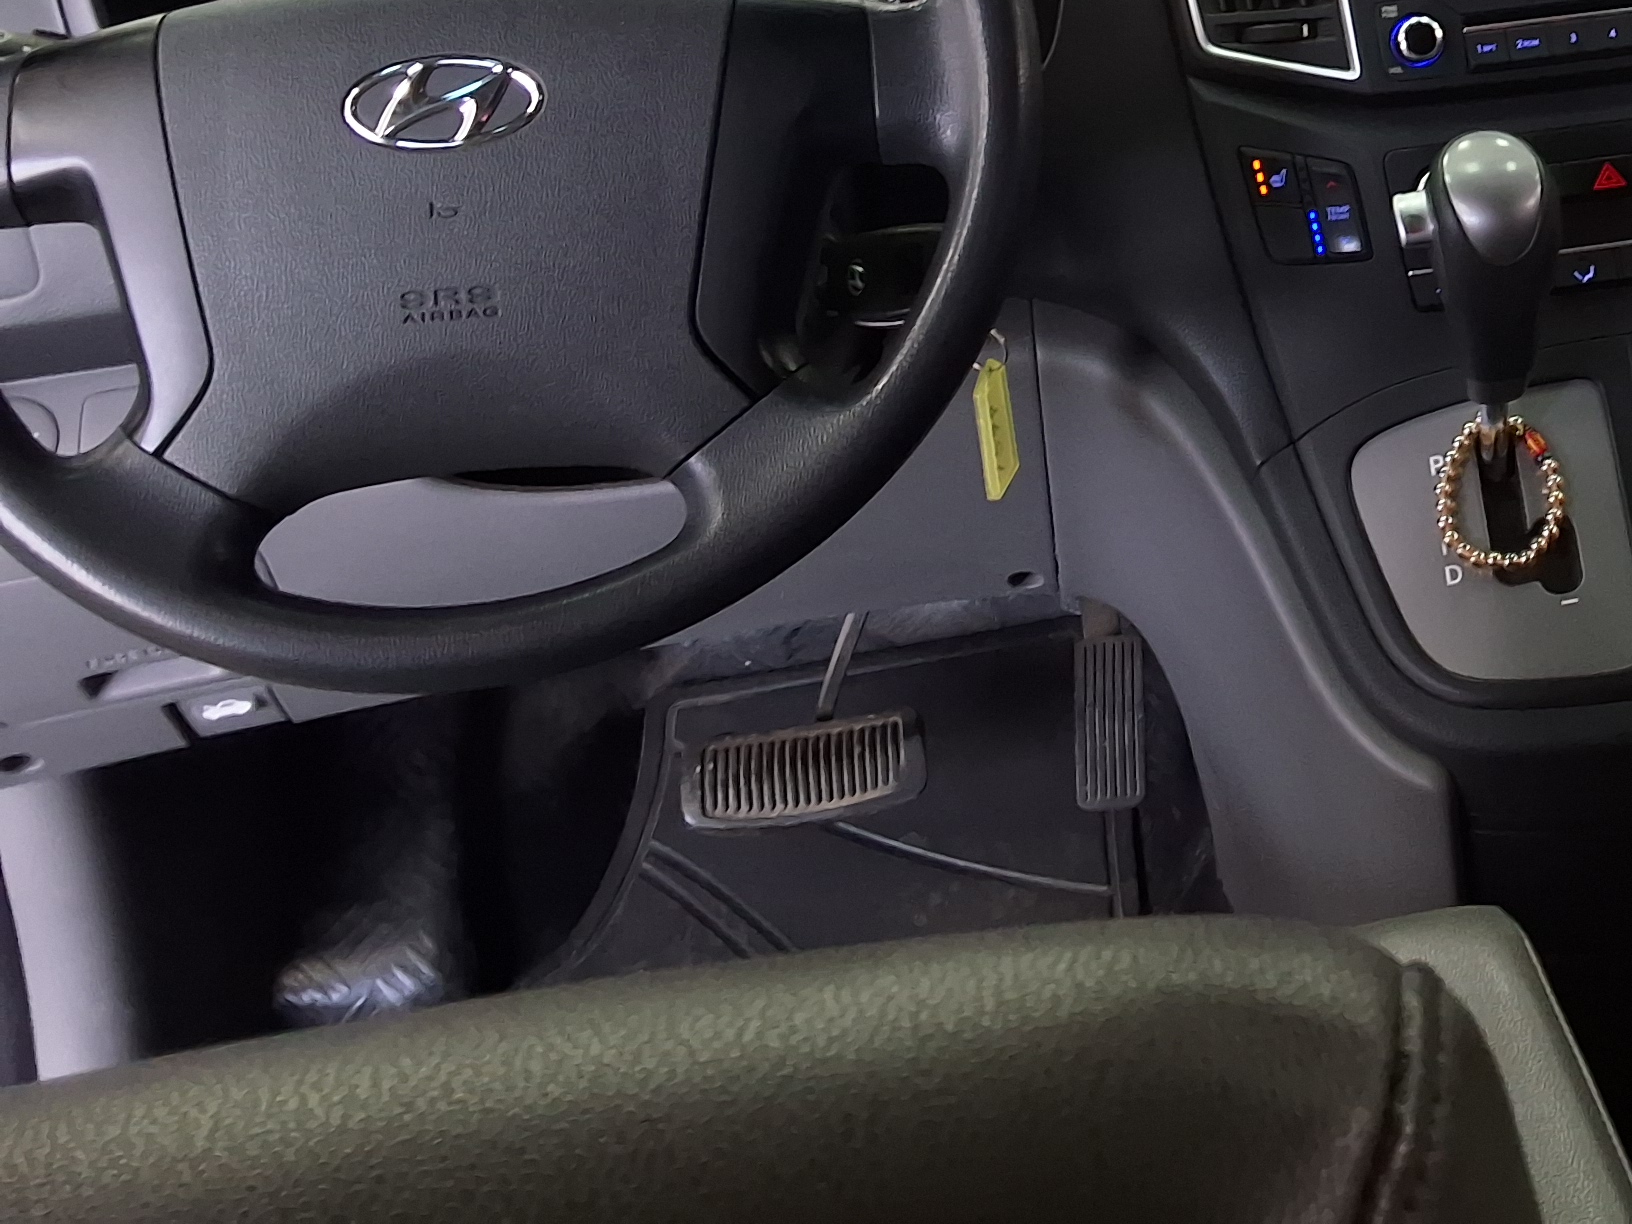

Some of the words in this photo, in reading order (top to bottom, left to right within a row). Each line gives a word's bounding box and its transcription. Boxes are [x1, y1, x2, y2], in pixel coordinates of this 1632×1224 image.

[402, 306, 500, 325] AIRBAG
[1429, 455, 1444, 476] P
[1444, 565, 1463, 587] D
